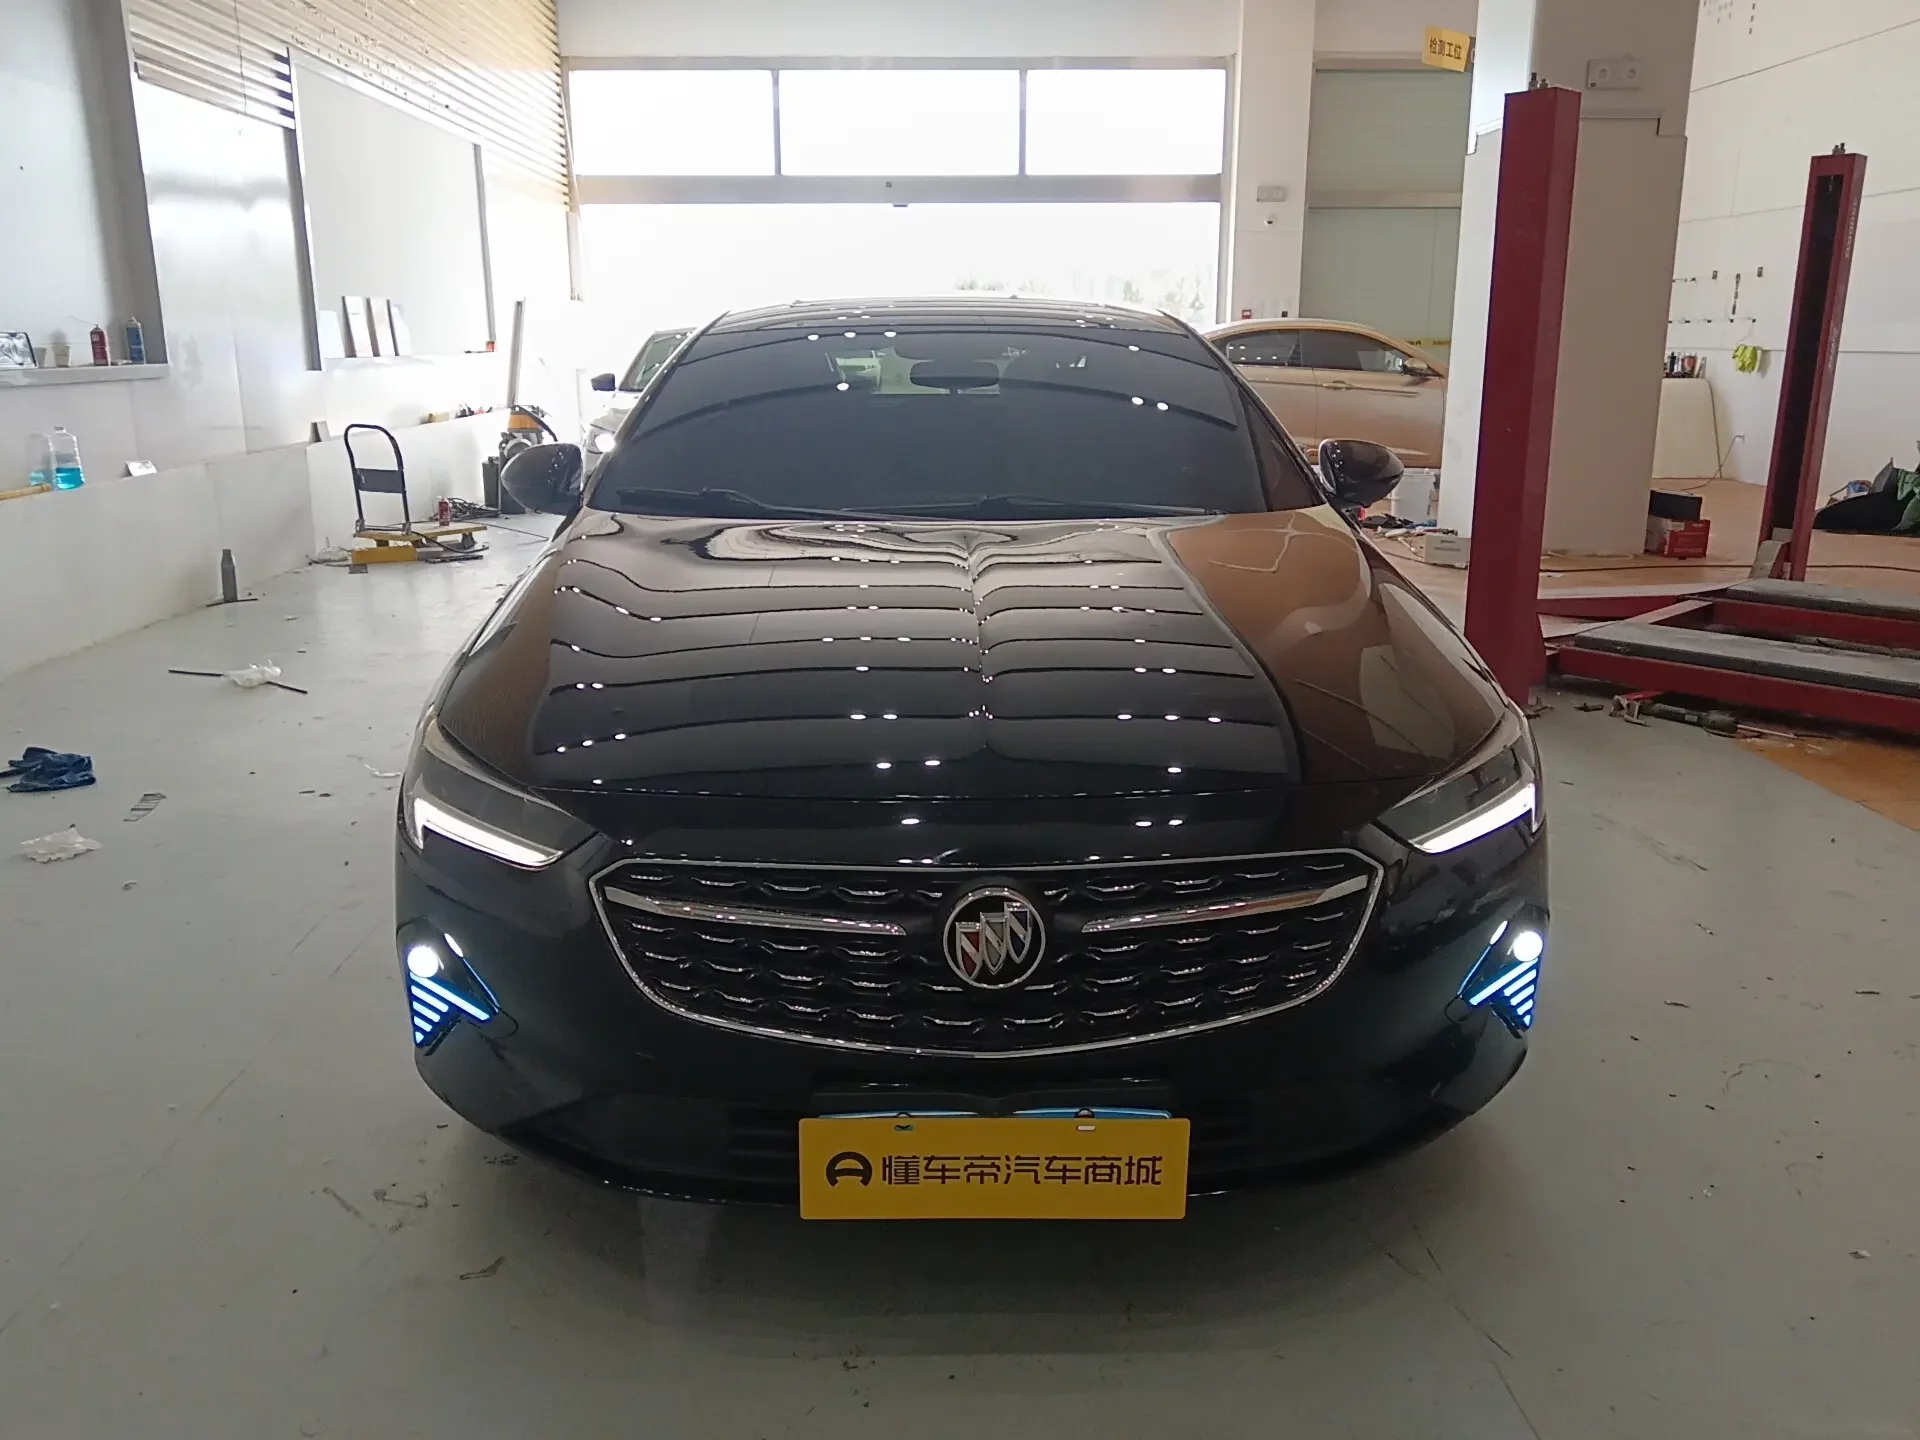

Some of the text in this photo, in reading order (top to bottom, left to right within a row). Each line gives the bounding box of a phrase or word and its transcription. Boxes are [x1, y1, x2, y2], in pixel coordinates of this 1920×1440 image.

[1429, 36, 1462, 60] 检测工位
[882, 1155, 1163, 1186] 懂车帝汽车商城
